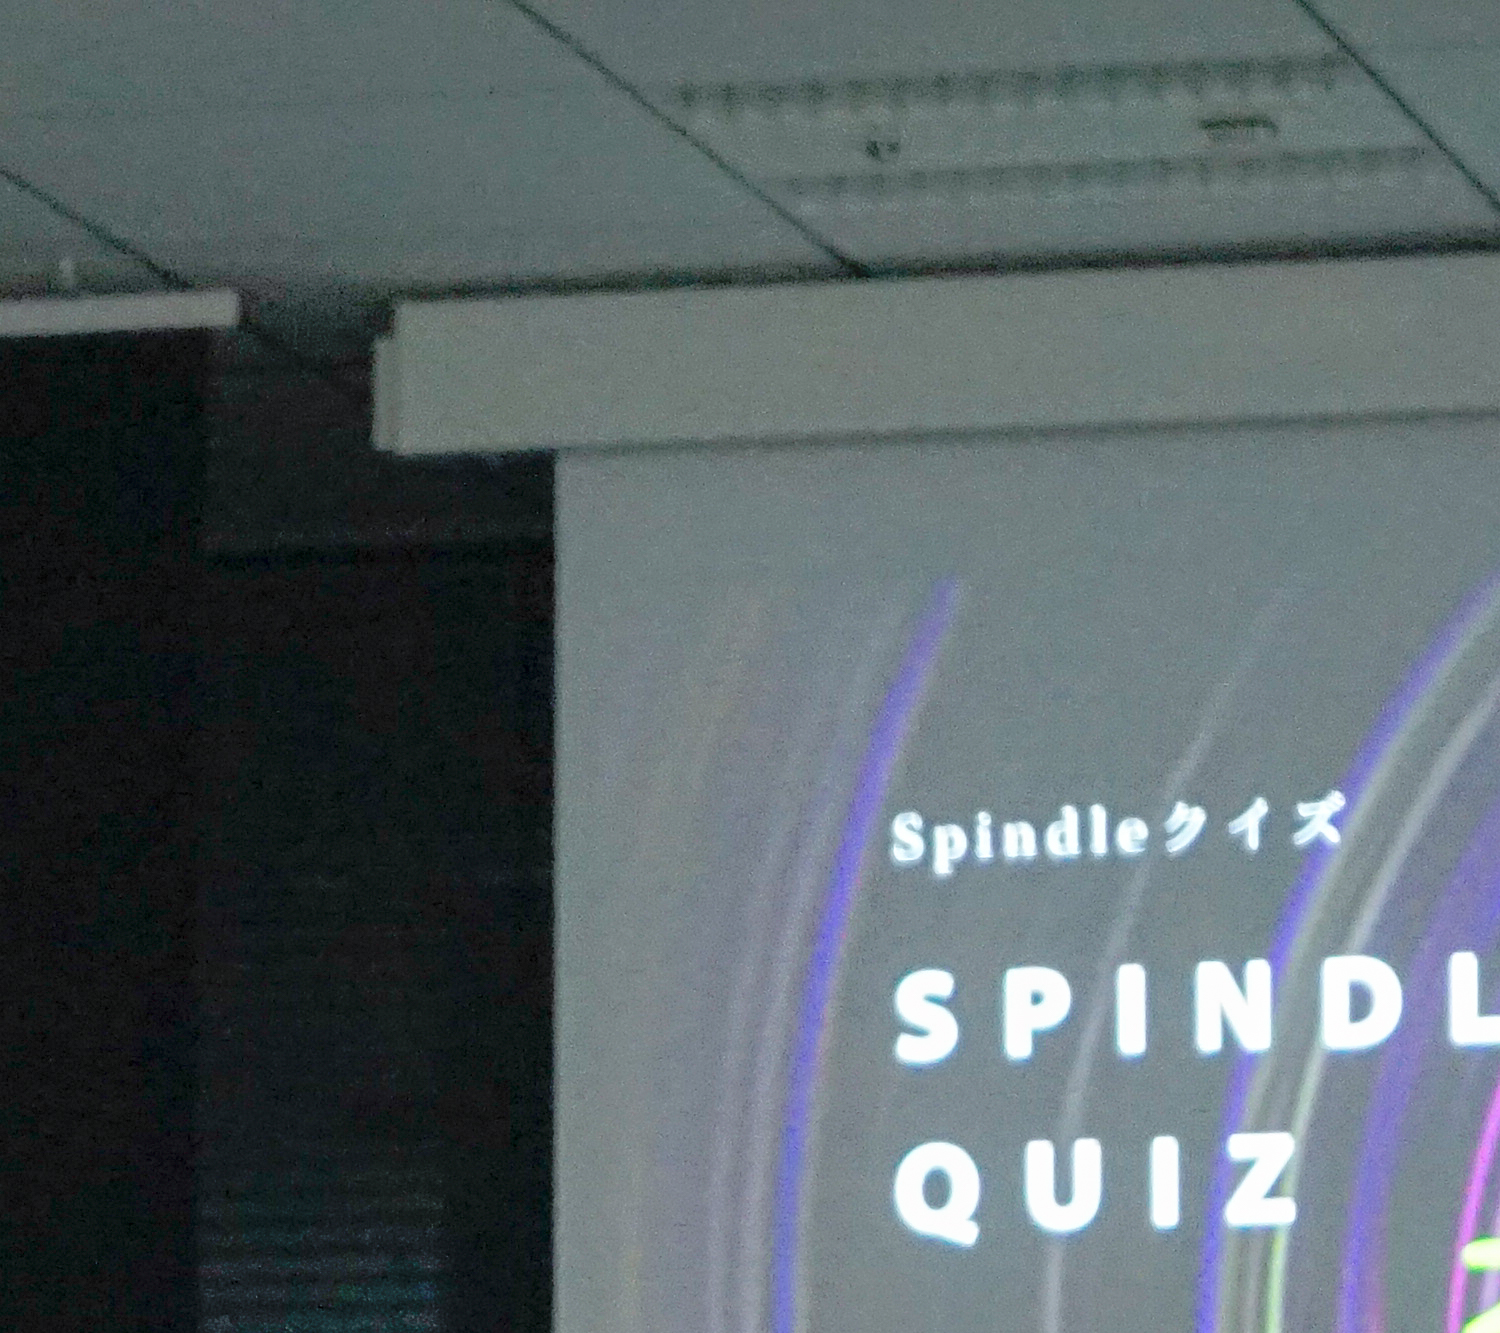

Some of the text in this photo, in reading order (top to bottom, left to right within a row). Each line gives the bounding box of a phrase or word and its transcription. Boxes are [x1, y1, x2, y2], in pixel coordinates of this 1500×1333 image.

[891, 789, 1346, 877] Spindleクイズ
[894, 1130, 1297, 1248] QUIZ
